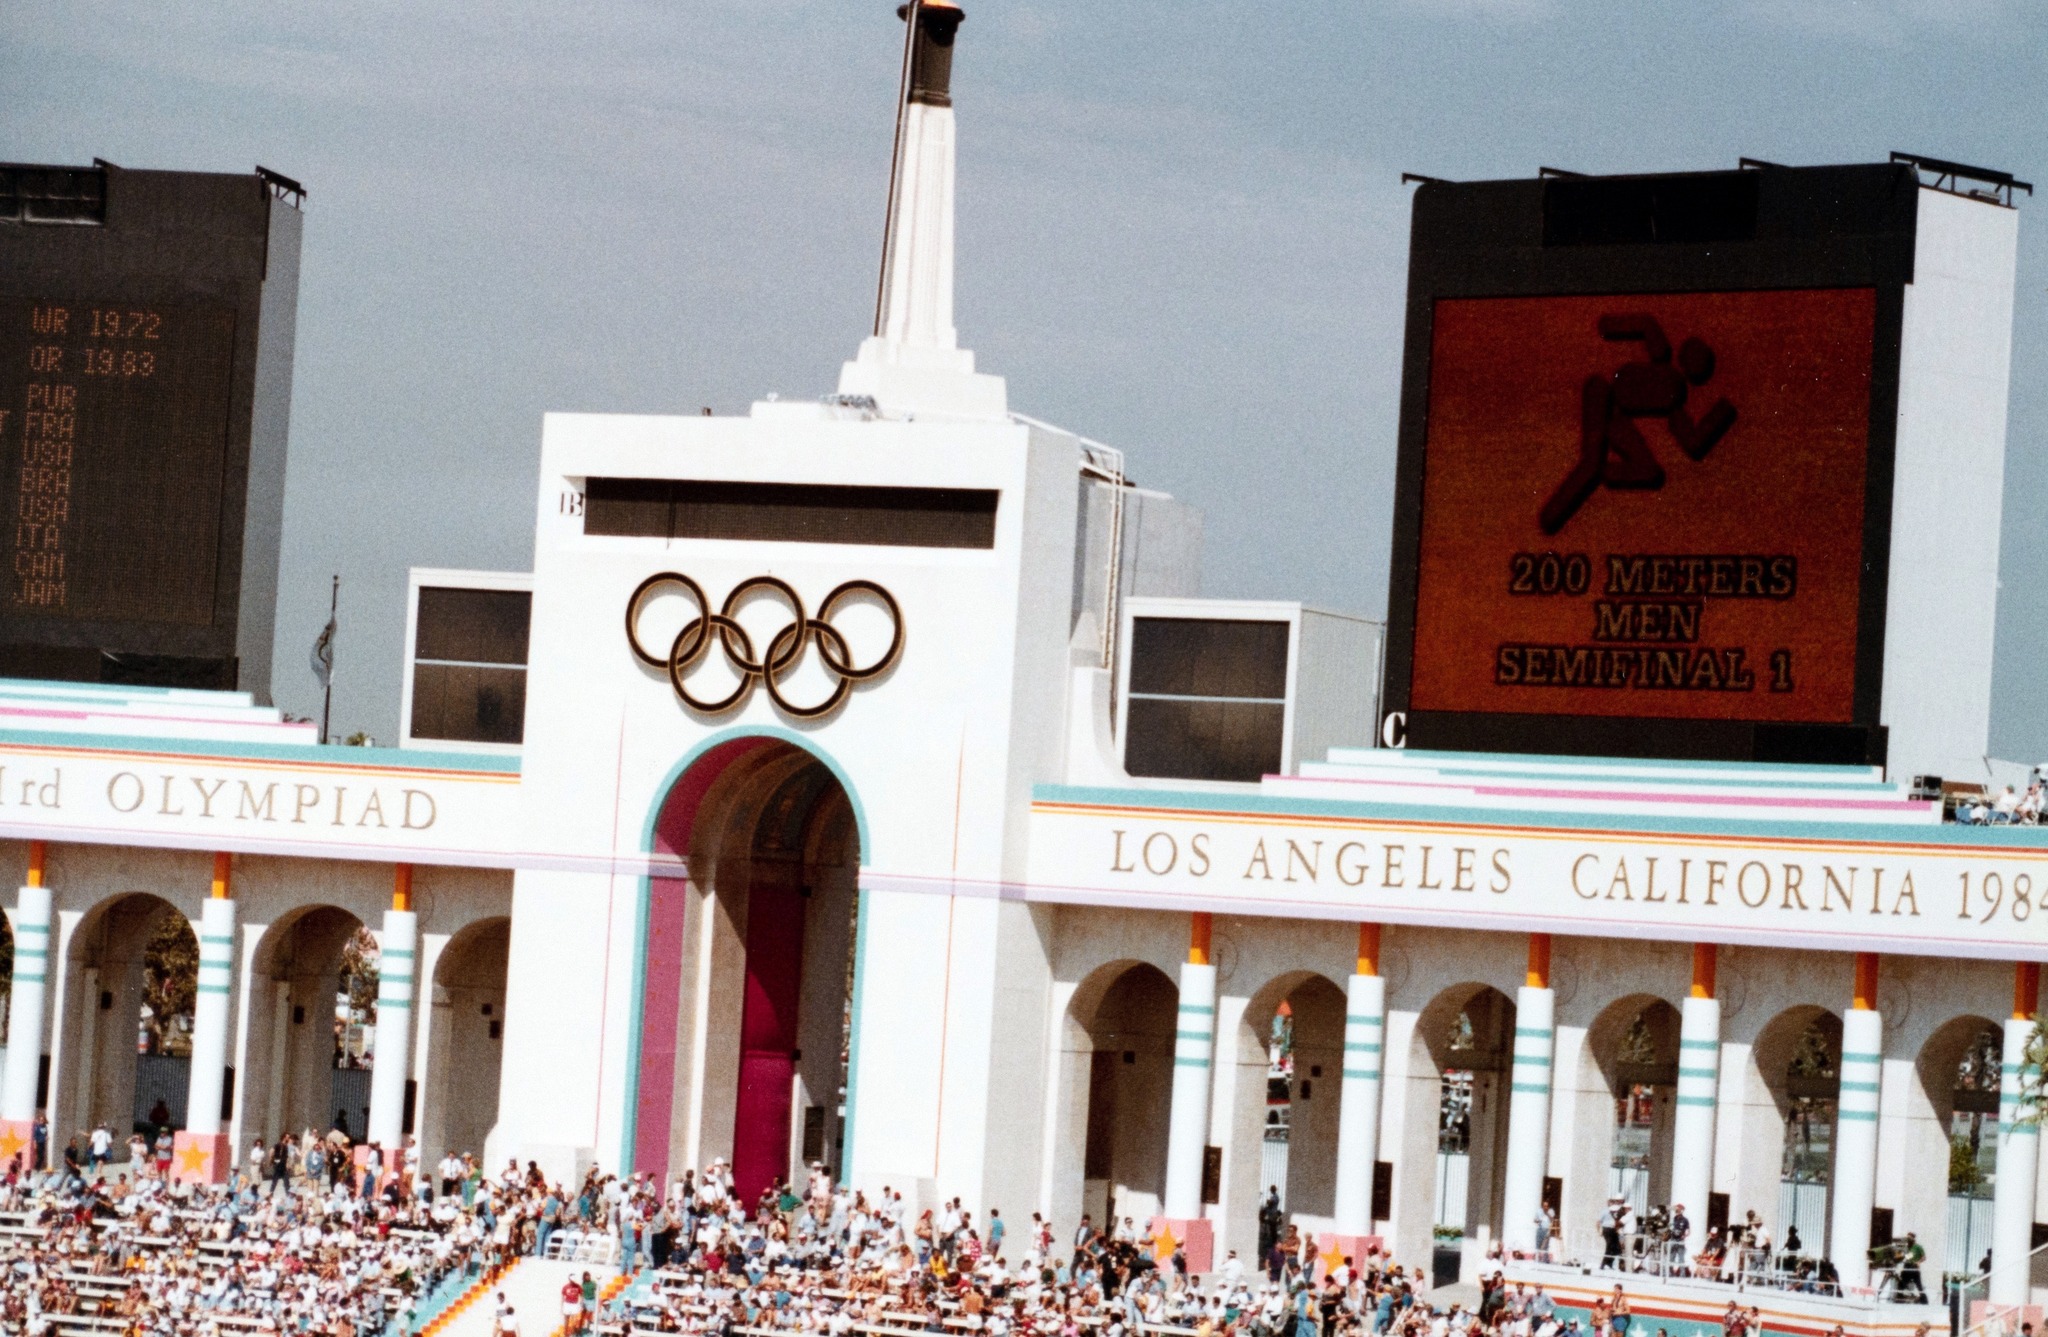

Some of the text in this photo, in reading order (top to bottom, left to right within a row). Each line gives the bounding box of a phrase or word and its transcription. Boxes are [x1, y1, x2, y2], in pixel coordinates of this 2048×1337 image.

[32, 305, 161, 339] WR 19.72
[29, 345, 155, 378] OR 19.83
[27, 383, 77, 412] PUR
[25, 411, 74, 438] FRA
[23, 439, 72, 467] USA
[20, 466, 70, 494] BRA
[19, 494, 68, 522] USA
[560, 491, 584, 517] B
[15, 522, 59, 550] ITA
[1511, 555, 1794, 596] 200 METERS
[12, 578, 66, 605] JAM
[1596, 603, 1698, 640] MEN
[1498, 648, 1791, 690] SEMIFINAL 1
[1382, 711, 1406, 749] C
[106, 770, 439, 830] OLYMPIAD
[1110, 829, 1211, 877] LOS
[1242, 836, 1512, 894] ANGELES
[1570, 852, 1921, 917] CALIFORNIA
